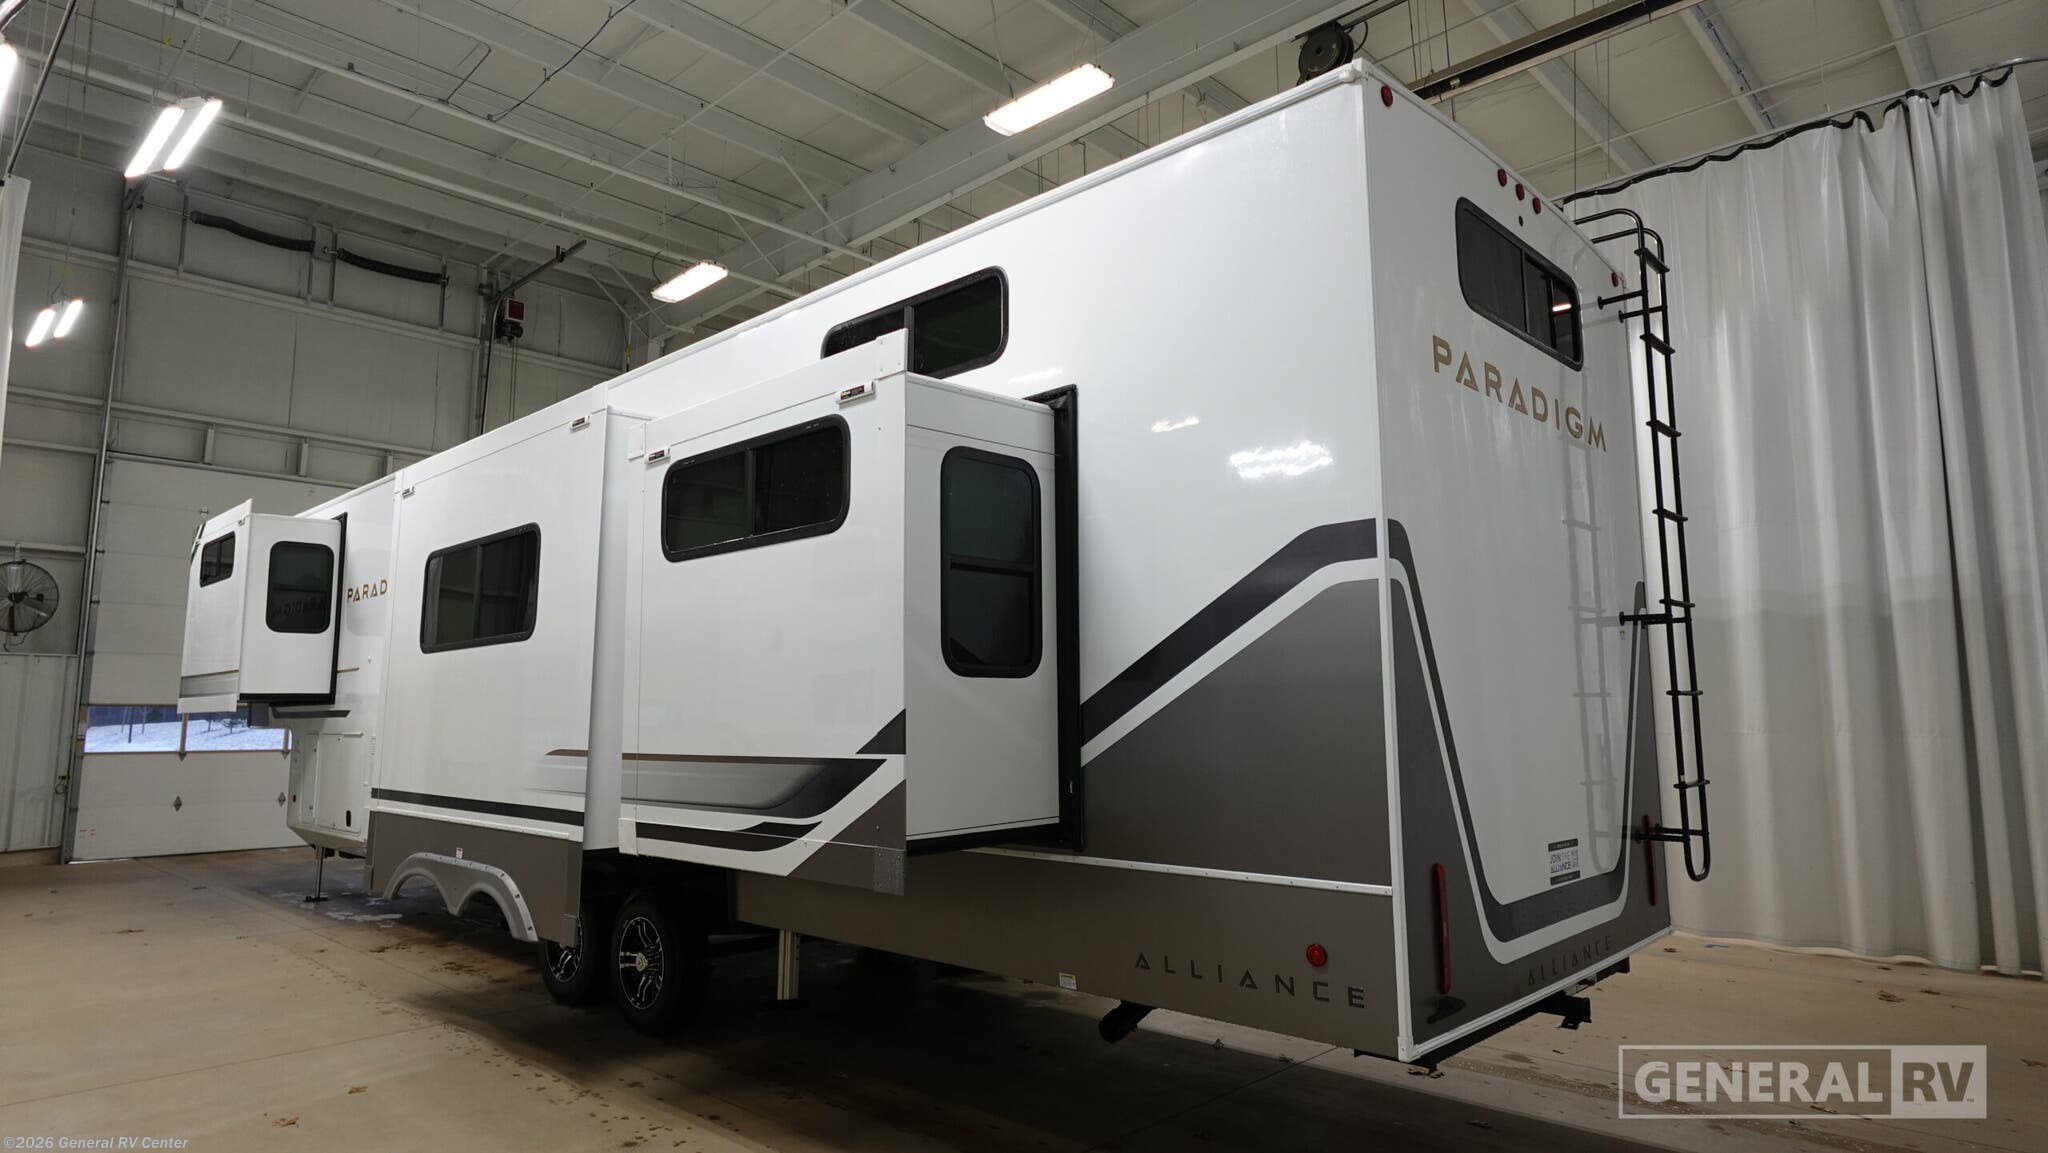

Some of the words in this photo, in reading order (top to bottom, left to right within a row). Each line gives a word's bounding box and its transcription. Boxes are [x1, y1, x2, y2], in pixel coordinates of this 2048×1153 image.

[1431, 335, 1607, 452] PARADIGM
[1135, 952, 1365, 1009] ALLIANCE
[1528, 936, 1612, 986] ALLIANCE
